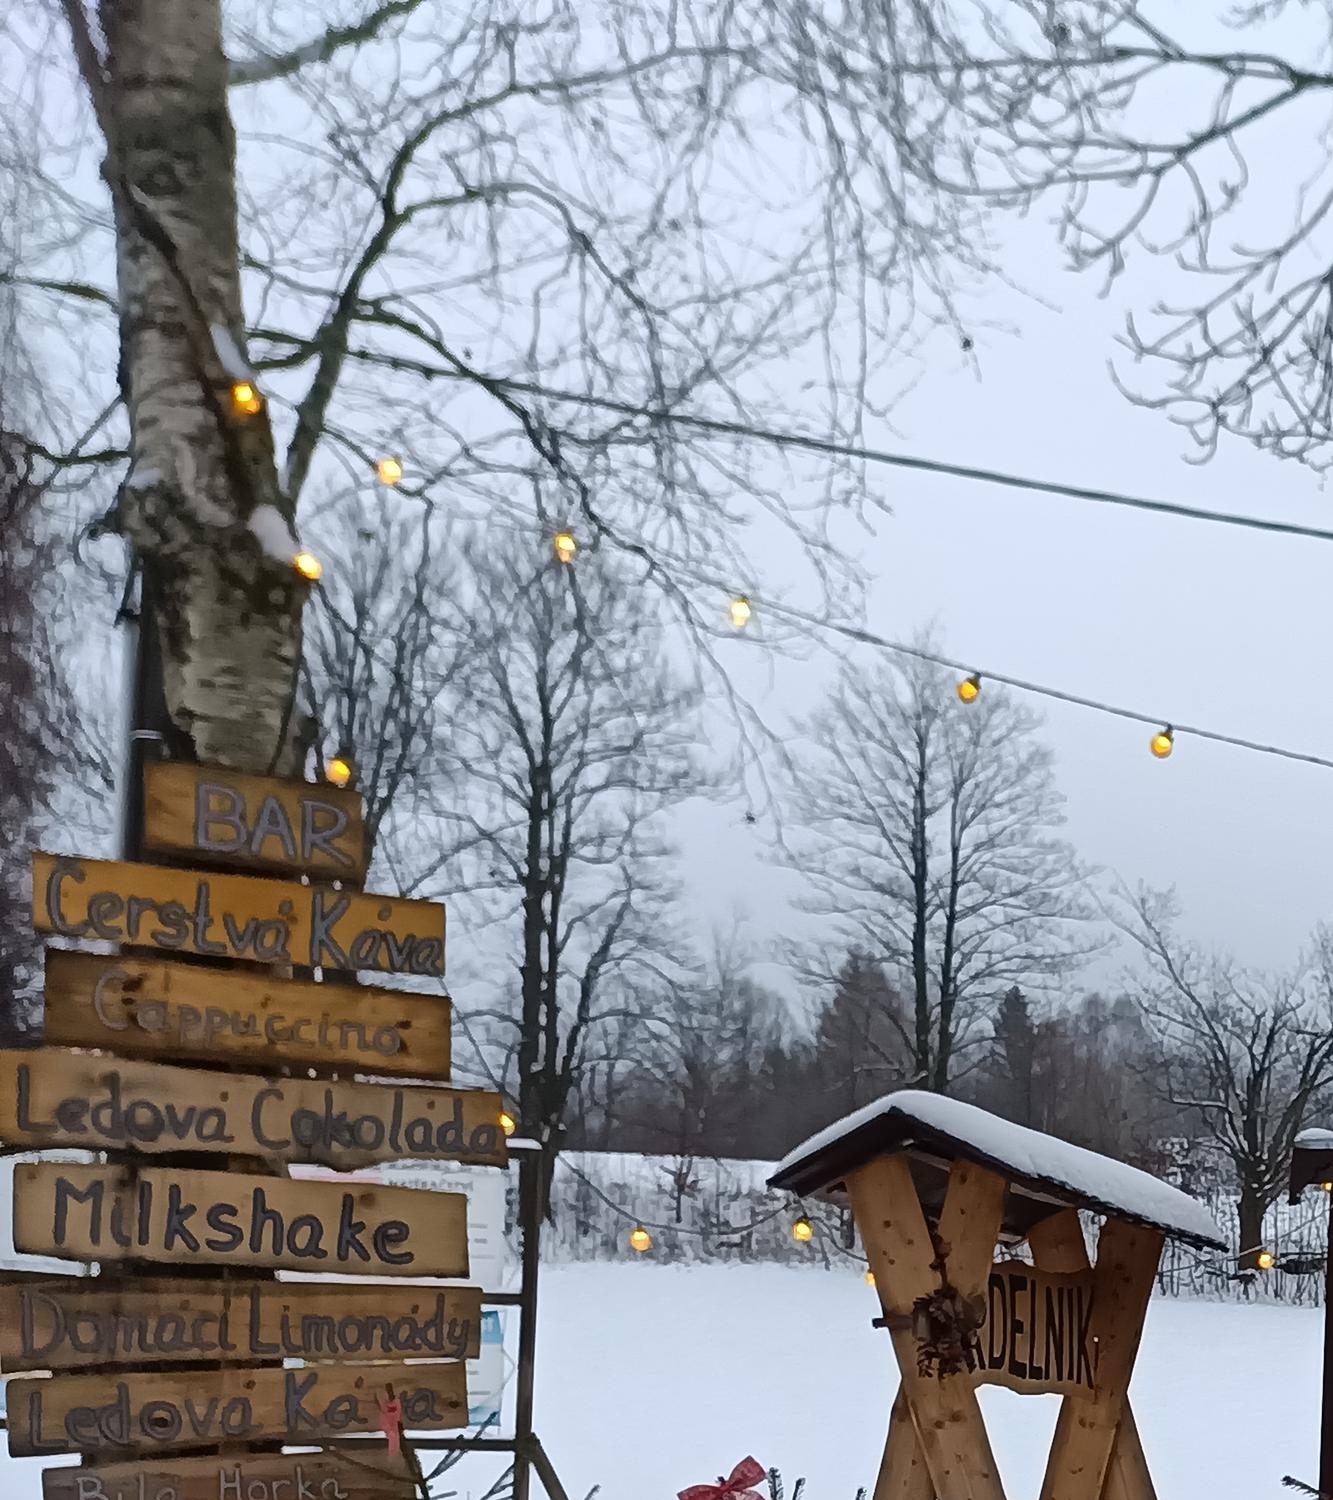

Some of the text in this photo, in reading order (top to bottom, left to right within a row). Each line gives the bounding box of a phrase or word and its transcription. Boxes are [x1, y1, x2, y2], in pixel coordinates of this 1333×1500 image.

[195, 782, 355, 868] BAR
[92, 969, 402, 1057] Cappuccino
[53, 1175, 415, 1266] Milkshake
